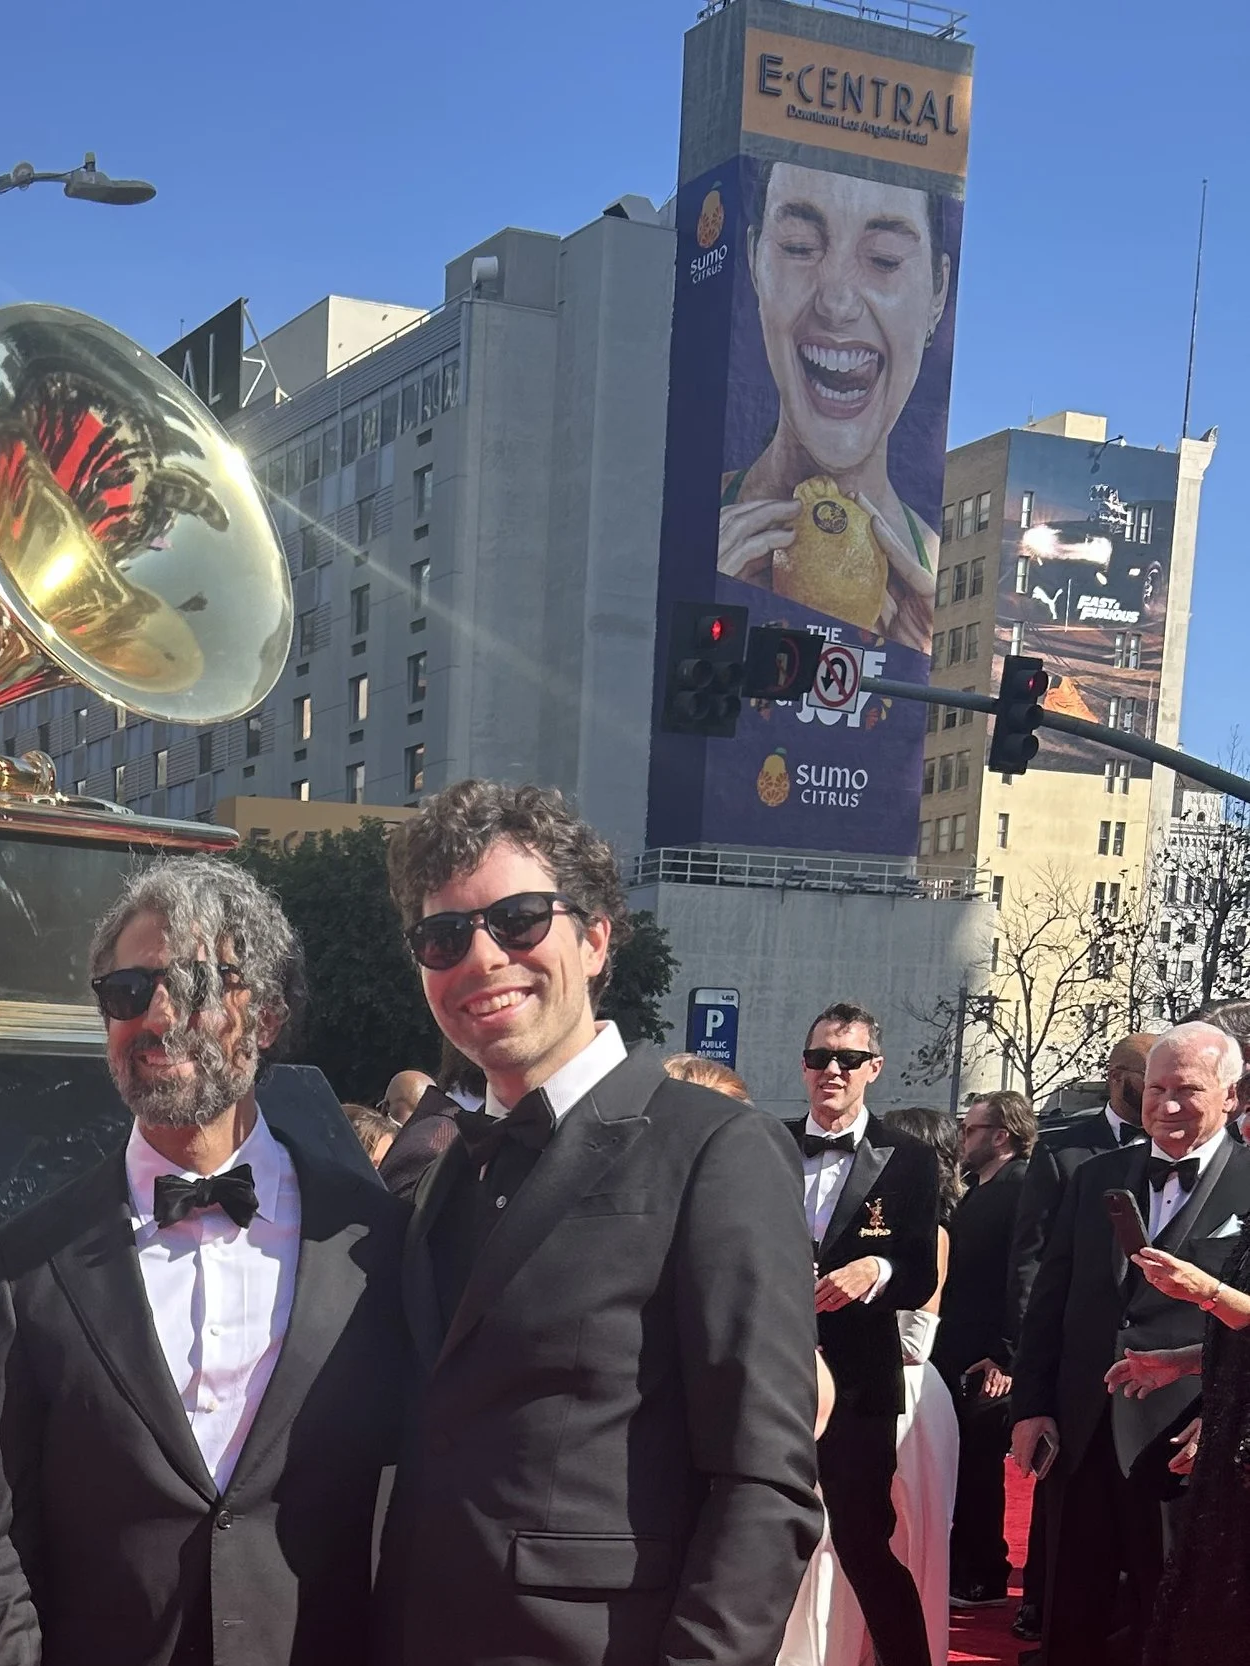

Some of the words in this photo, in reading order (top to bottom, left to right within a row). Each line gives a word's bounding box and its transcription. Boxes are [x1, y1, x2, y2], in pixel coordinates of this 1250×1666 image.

[787, 103, 839, 128] Downtown
[841, 116, 859, 131] Los
[860, 121, 900, 140] Angeles
[901, 129, 928, 146] Hotel
[692, 260, 723, 284] CITRUS
[1077, 594, 1117, 609] FAST
[1079, 606, 1140, 623] FURIOUS
[806, 624, 842, 643] THE
[801, 789, 860, 808] CITRUS
[705, 1009, 724, 1037] P
[700, 1040, 727, 1049] PUBLIC
[696, 1050, 730, 1059] PARKING
